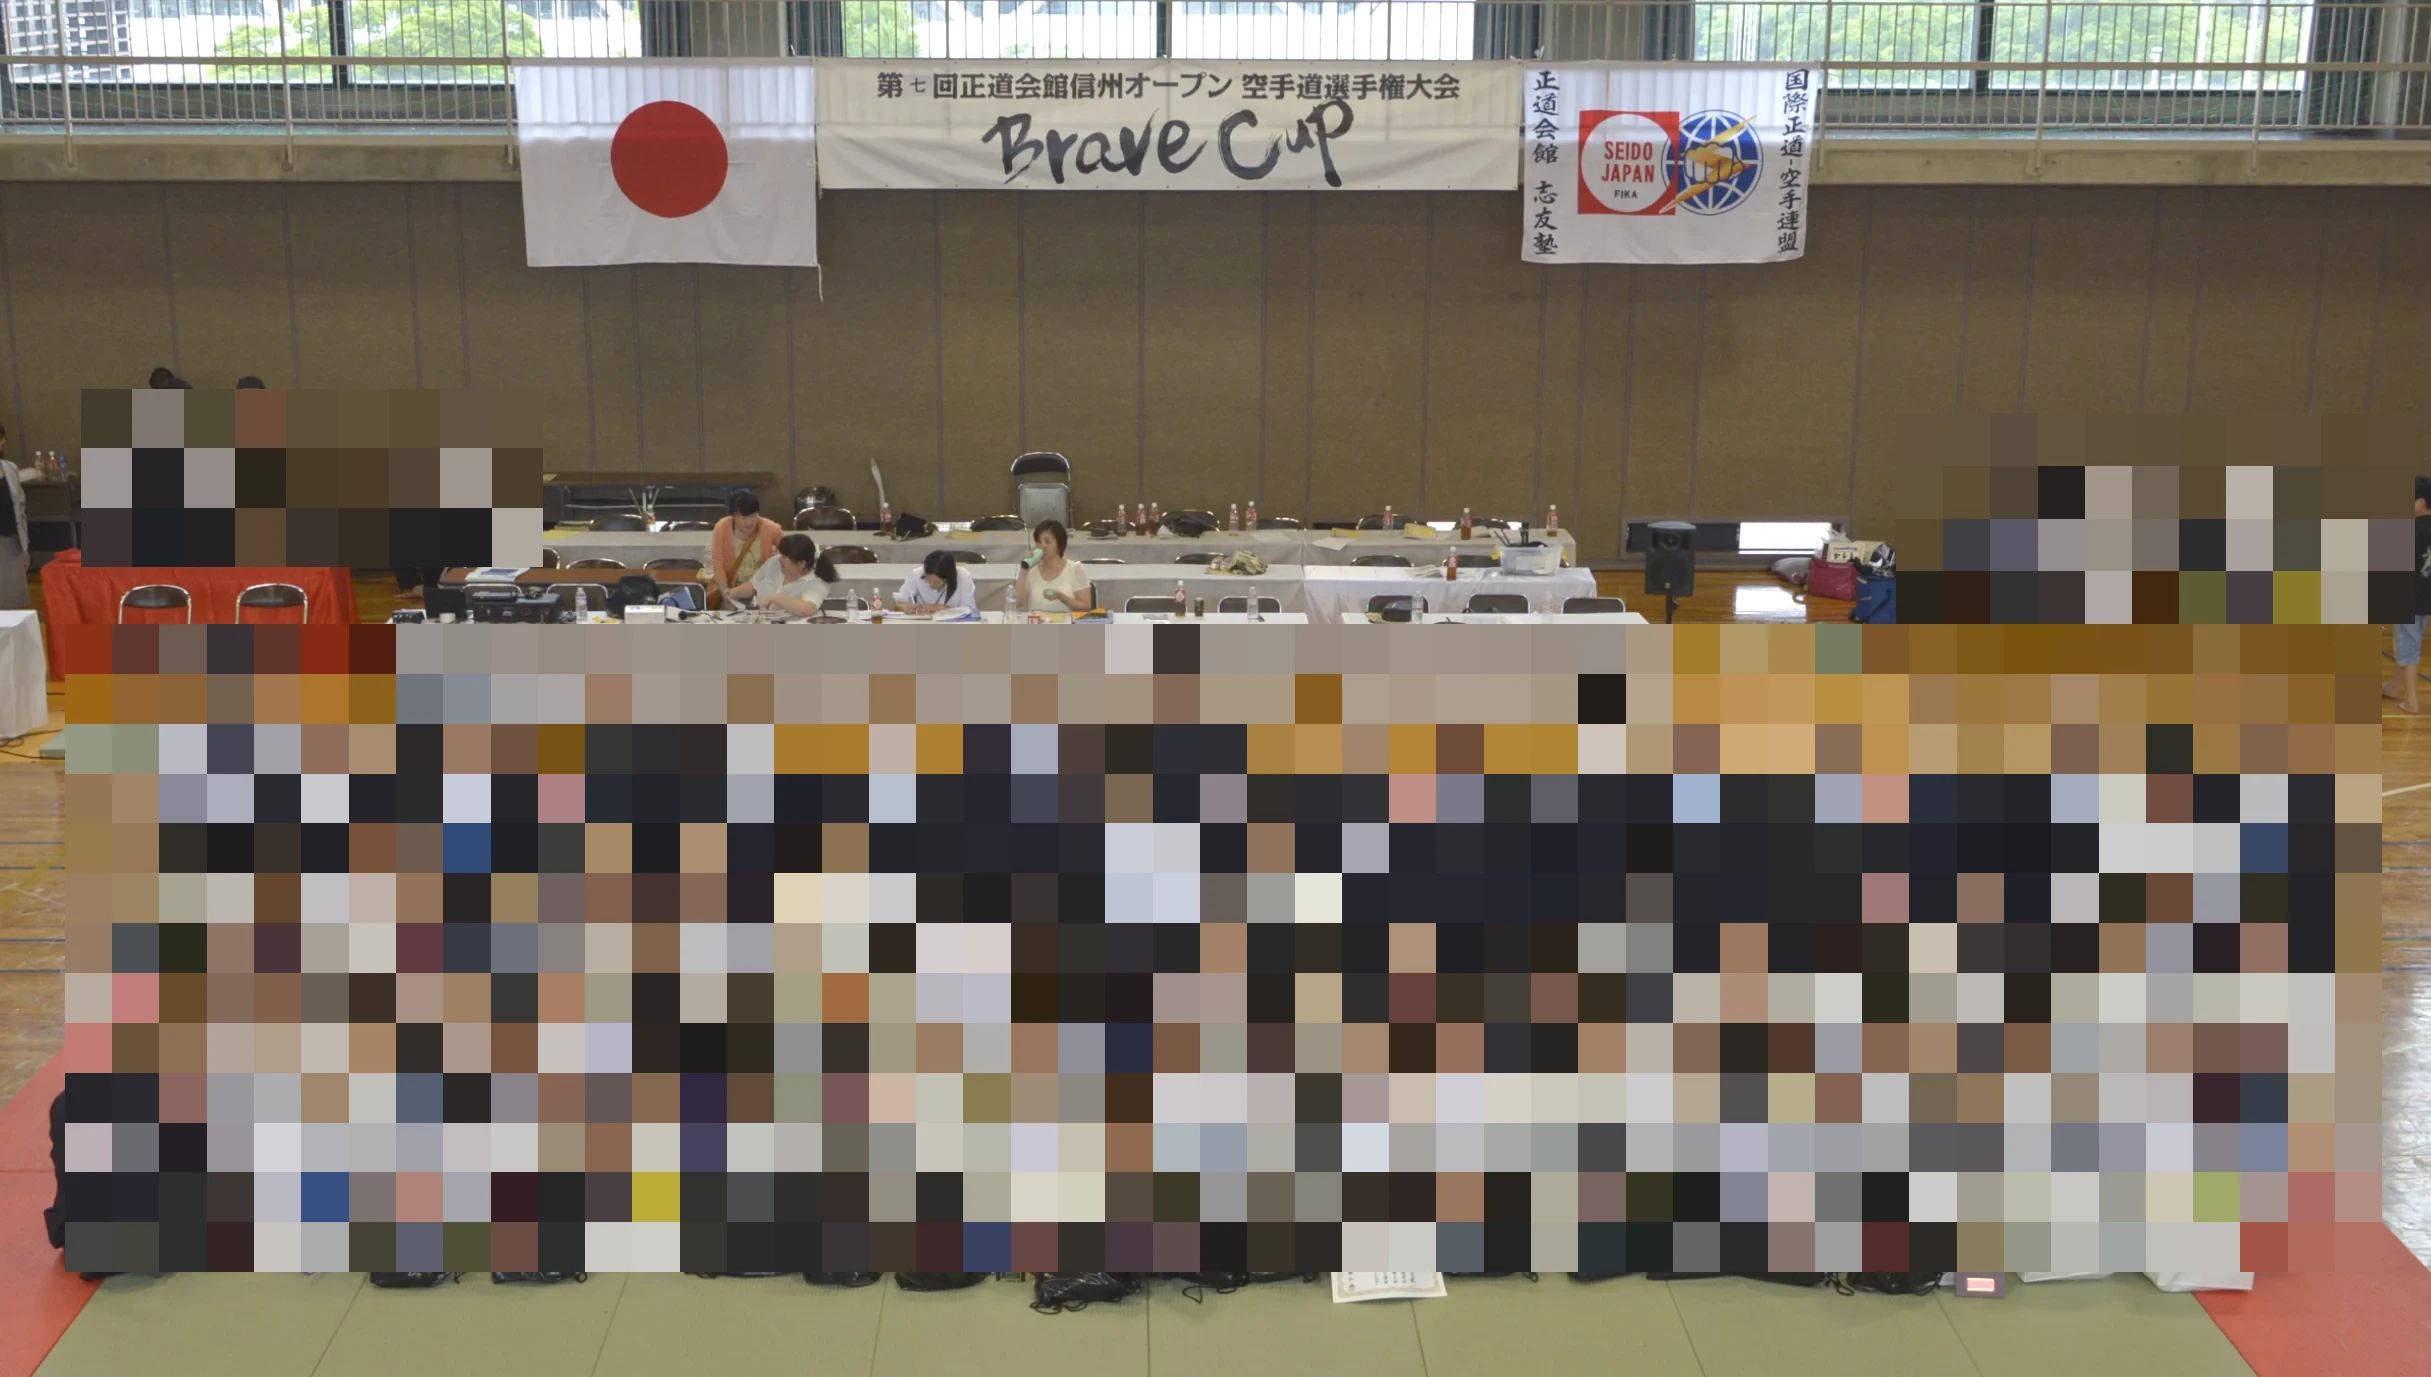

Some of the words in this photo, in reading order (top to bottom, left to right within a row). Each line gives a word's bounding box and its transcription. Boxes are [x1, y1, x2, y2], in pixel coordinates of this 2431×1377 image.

[877, 72, 1233, 99] 第七回正道会館信州オープン
[1242, 73, 1461, 100] 空手道選手権大会
[1532, 70, 1560, 164] 正道会館
[981, 108, 1207, 185] Brave
[1603, 140, 1653, 161] SEIDO
[1601, 163, 1655, 183] JAPAN
[1614, 189, 1638, 199] FIKA
[1532, 180, 1558, 255] 志友塾
